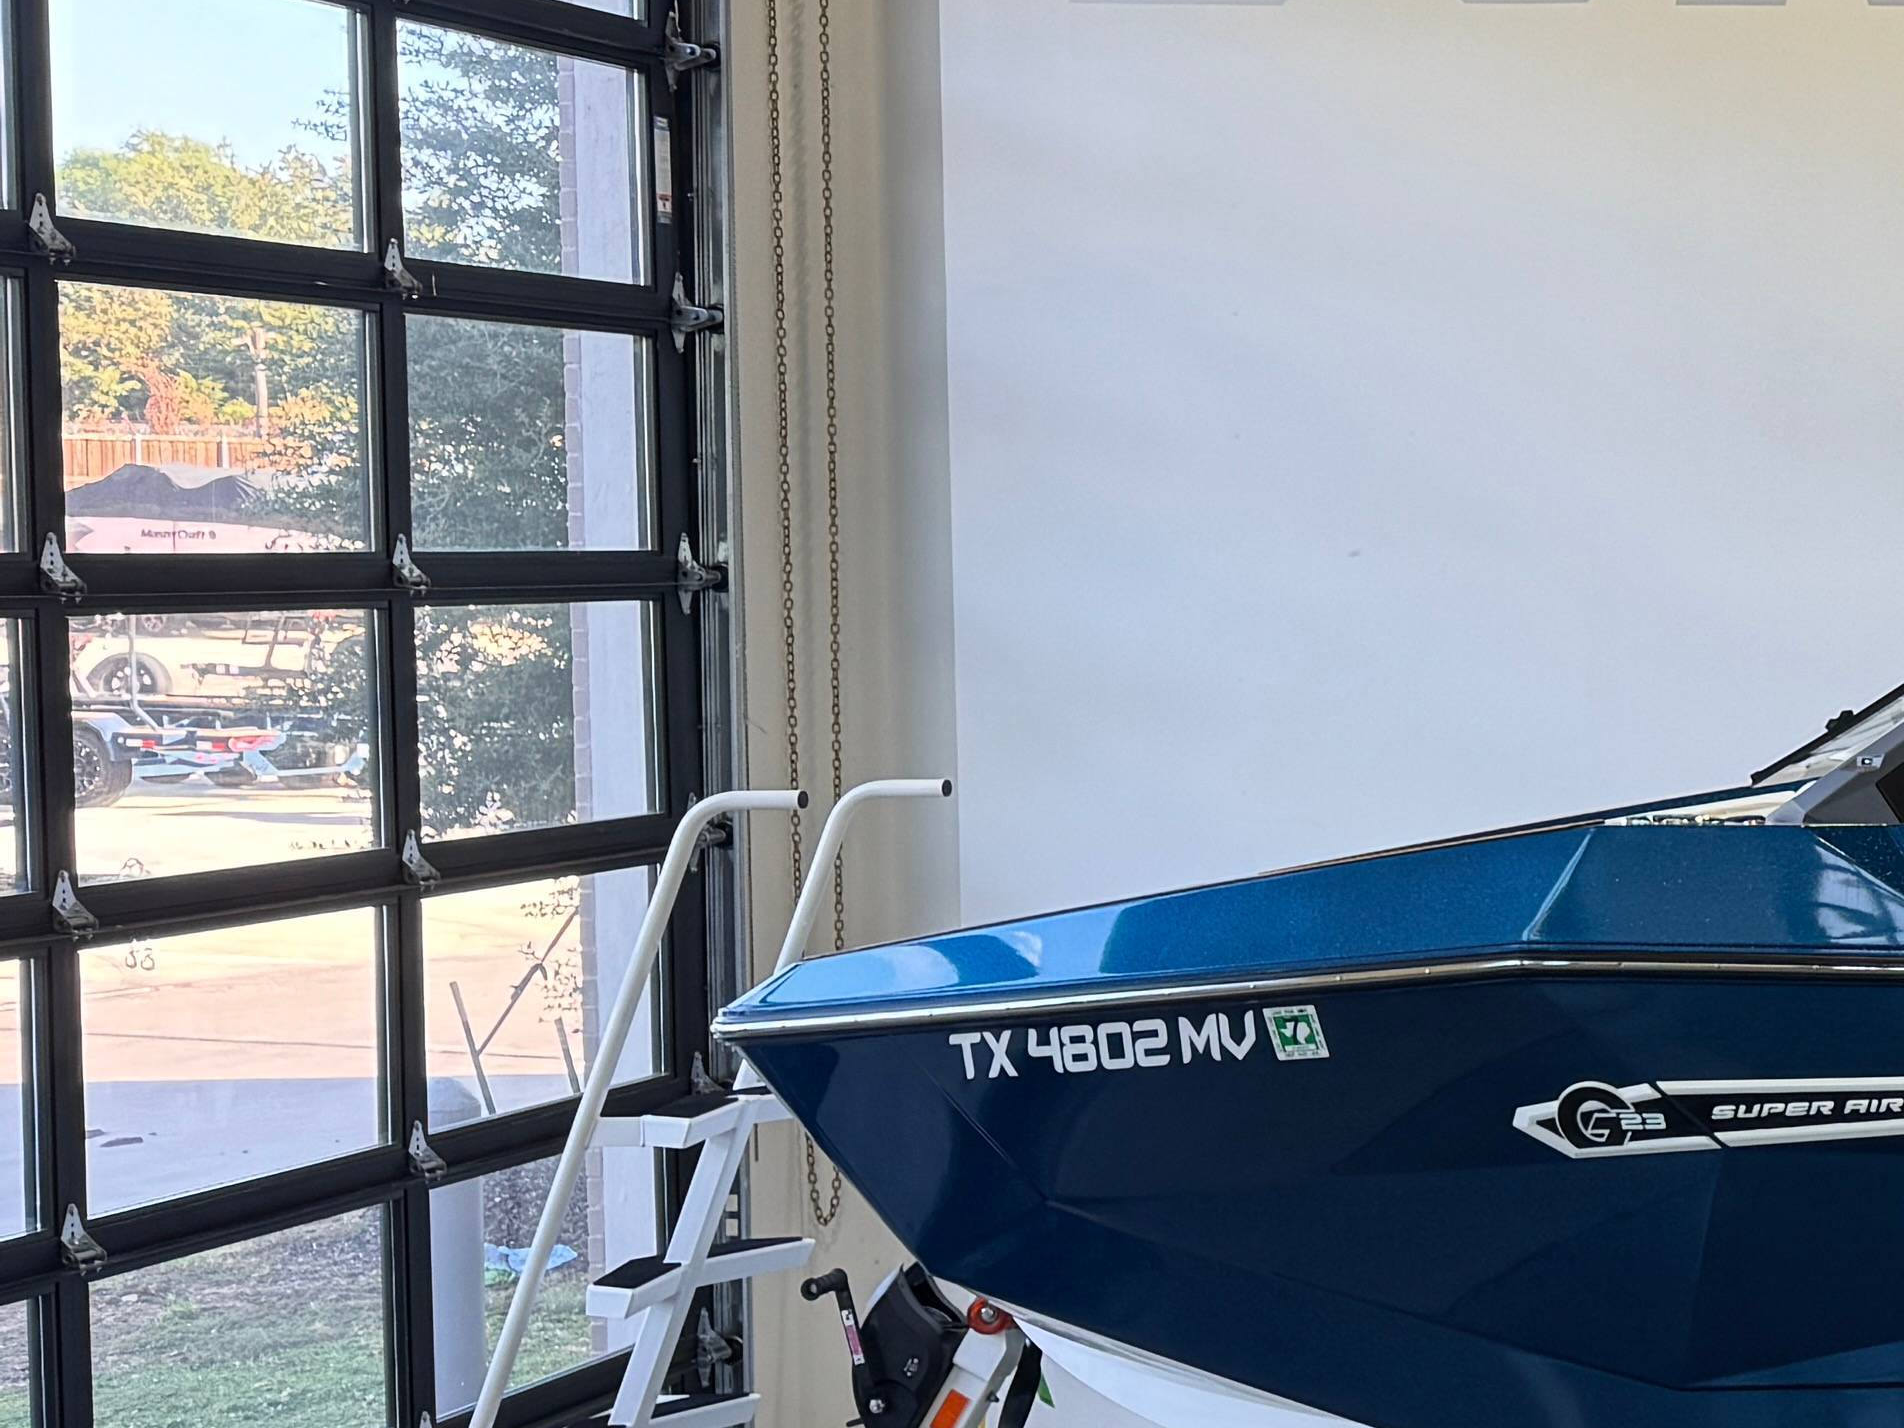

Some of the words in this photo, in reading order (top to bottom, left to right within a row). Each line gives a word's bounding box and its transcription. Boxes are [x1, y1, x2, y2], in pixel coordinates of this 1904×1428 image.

[948, 1029, 1019, 1080] TX
[1027, 1018, 1171, 1074] 4802
[1178, 1010, 1257, 1065] MV
[1710, 1100, 1834, 1121] SUPER
[1843, 1097, 1904, 1116] AIR
